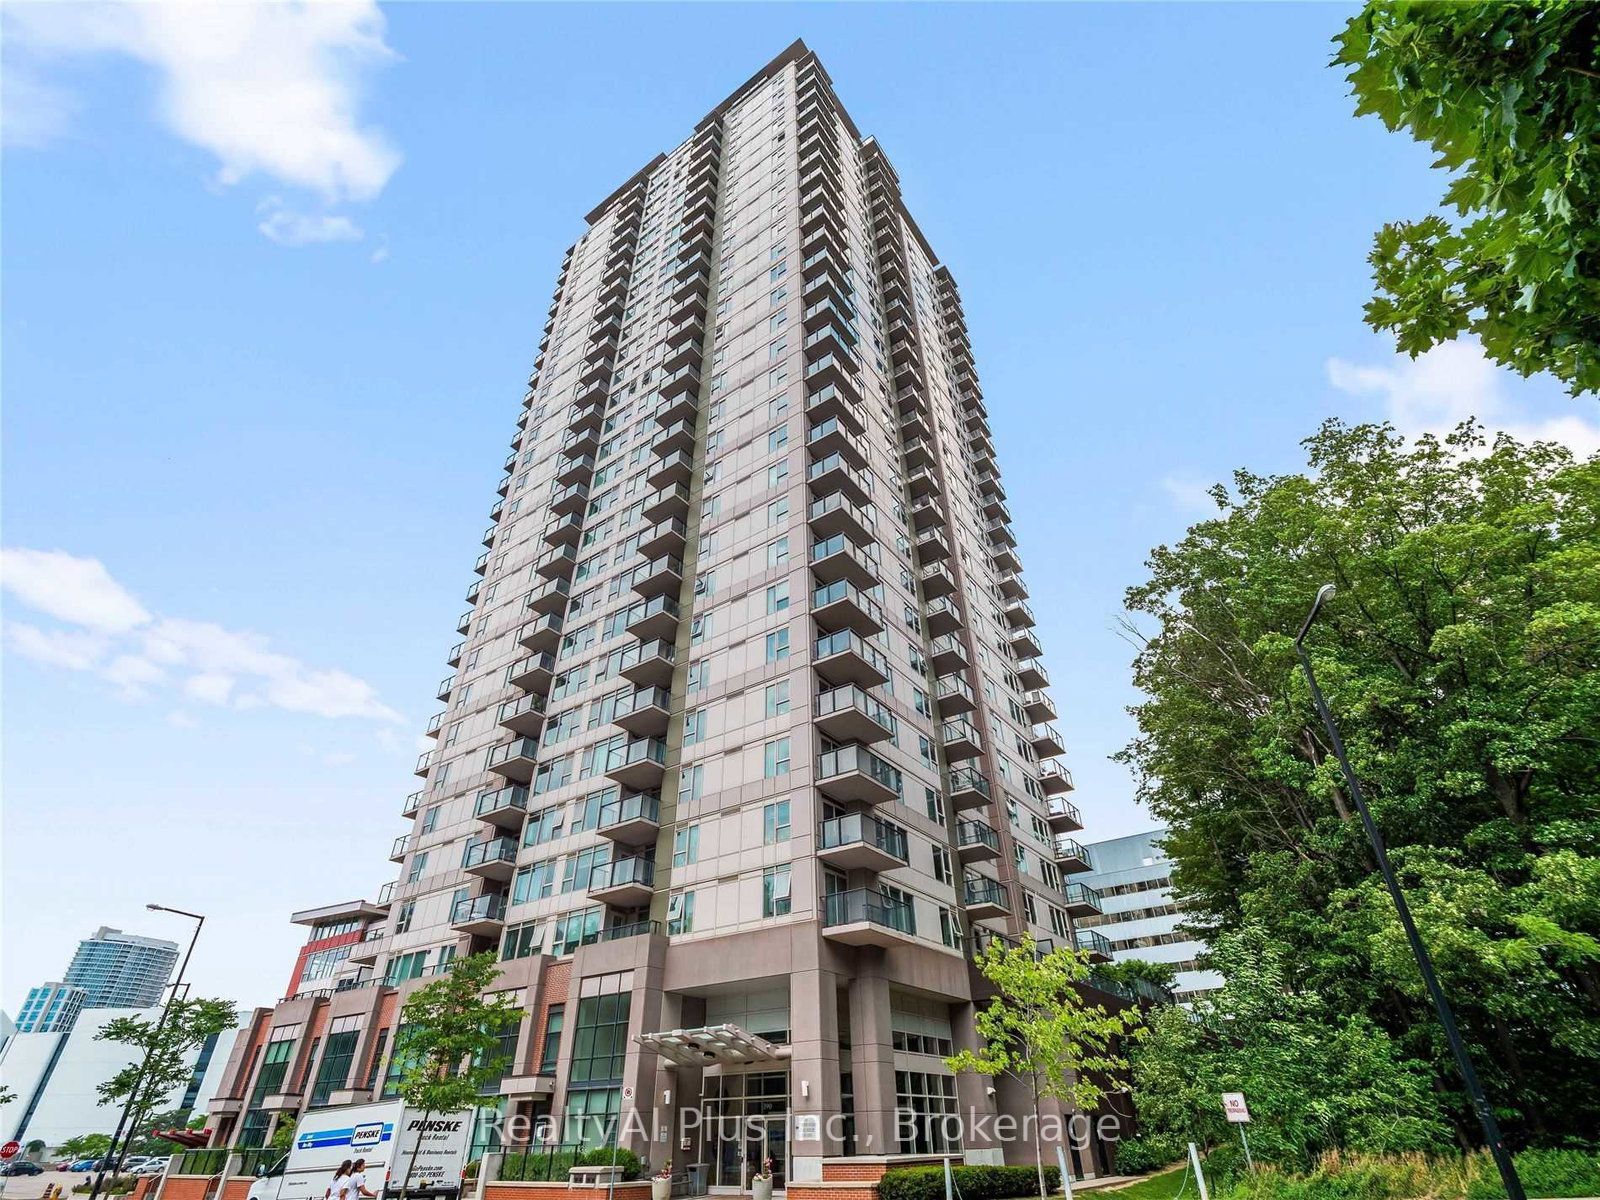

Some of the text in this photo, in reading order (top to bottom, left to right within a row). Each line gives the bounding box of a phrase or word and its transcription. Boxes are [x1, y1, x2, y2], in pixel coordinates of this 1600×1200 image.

[1229, 1099, 1239, 1107] NO
[407, 1120, 462, 1132] PENSKE
[355, 1130, 380, 1140] PENSKE
